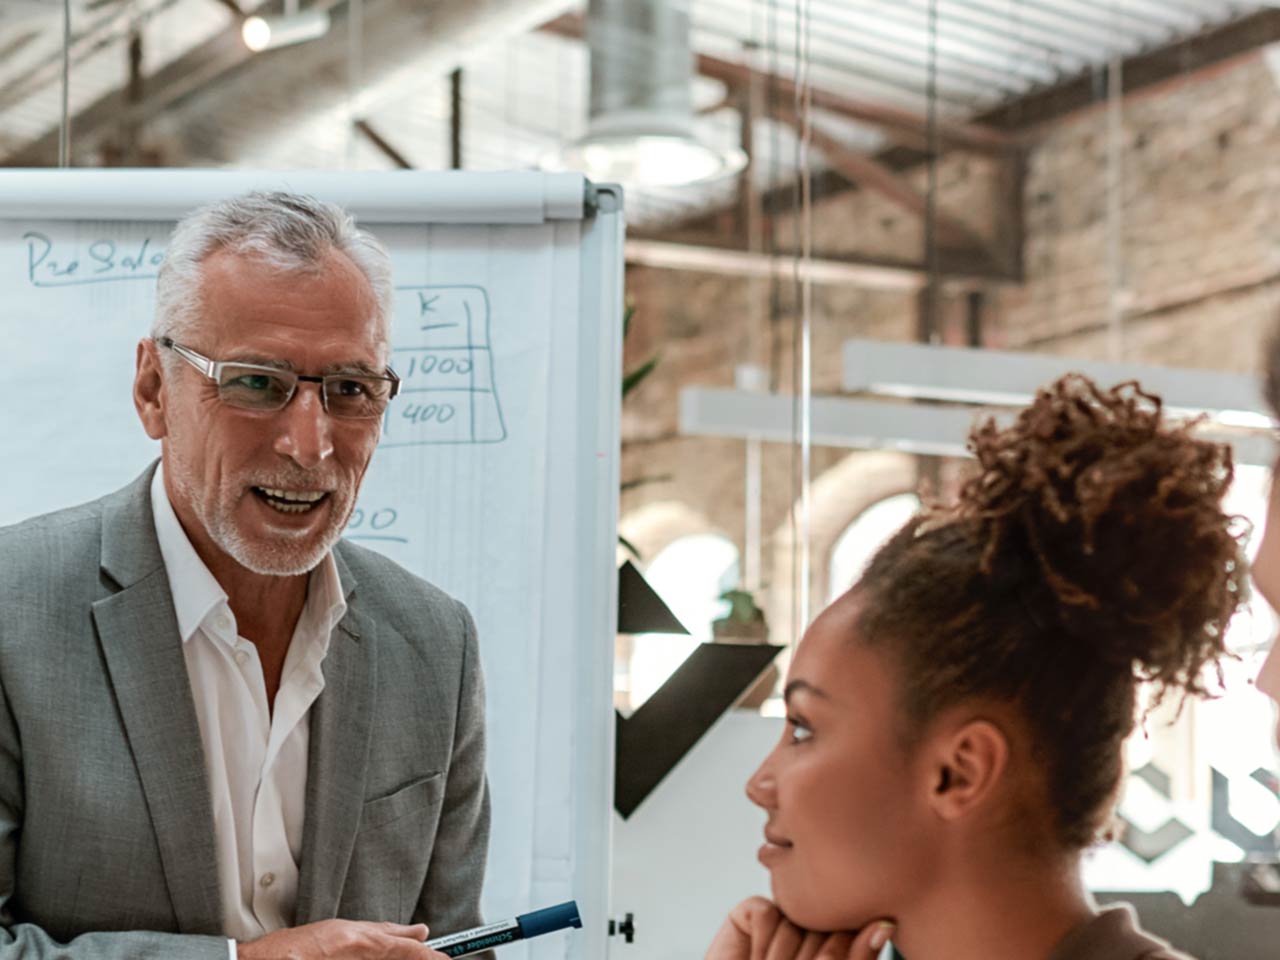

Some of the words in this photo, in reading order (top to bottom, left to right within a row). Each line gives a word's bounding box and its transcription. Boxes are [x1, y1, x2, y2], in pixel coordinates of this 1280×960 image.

[23, 231, 79, 282] Pre
[408, 355, 472, 378] 1000
[402, 403, 455, 424] 400
[467, 931, 513, 950] Schneider
